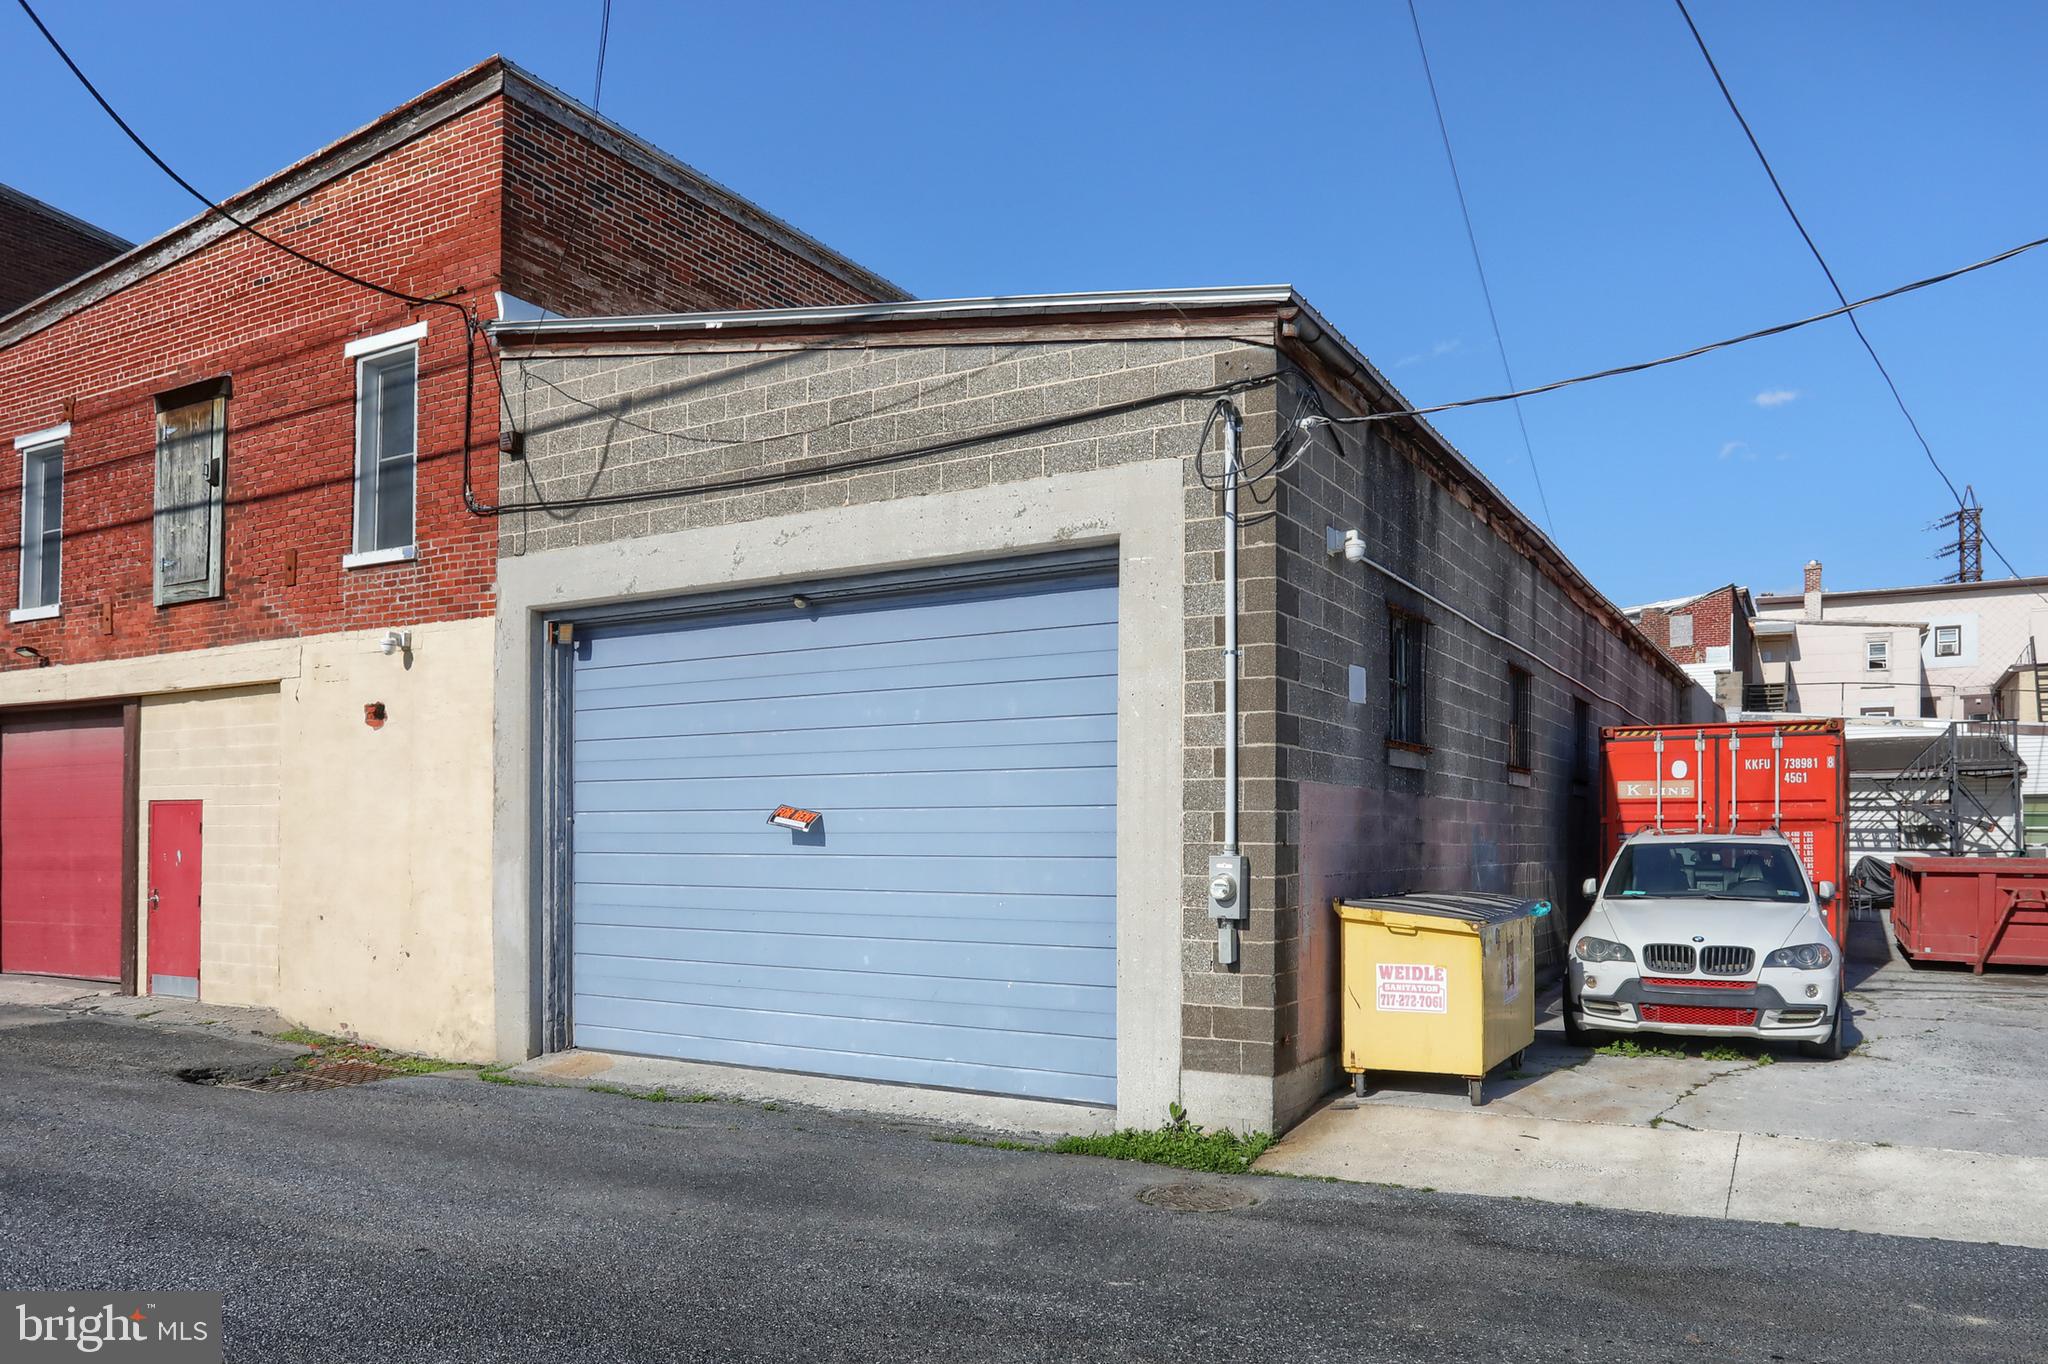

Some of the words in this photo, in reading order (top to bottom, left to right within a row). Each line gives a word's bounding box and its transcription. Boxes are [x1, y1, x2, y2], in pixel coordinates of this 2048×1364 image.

[1745, 758, 1770, 770] KKFU
[1784, 757, 1818, 769] 738981
[1827, 756, 1835, 768] 8
[1784, 772, 1808, 784] 45G1
[1649, 787, 1691, 796] LINE
[1378, 965, 1444, 981] WEIDLE
